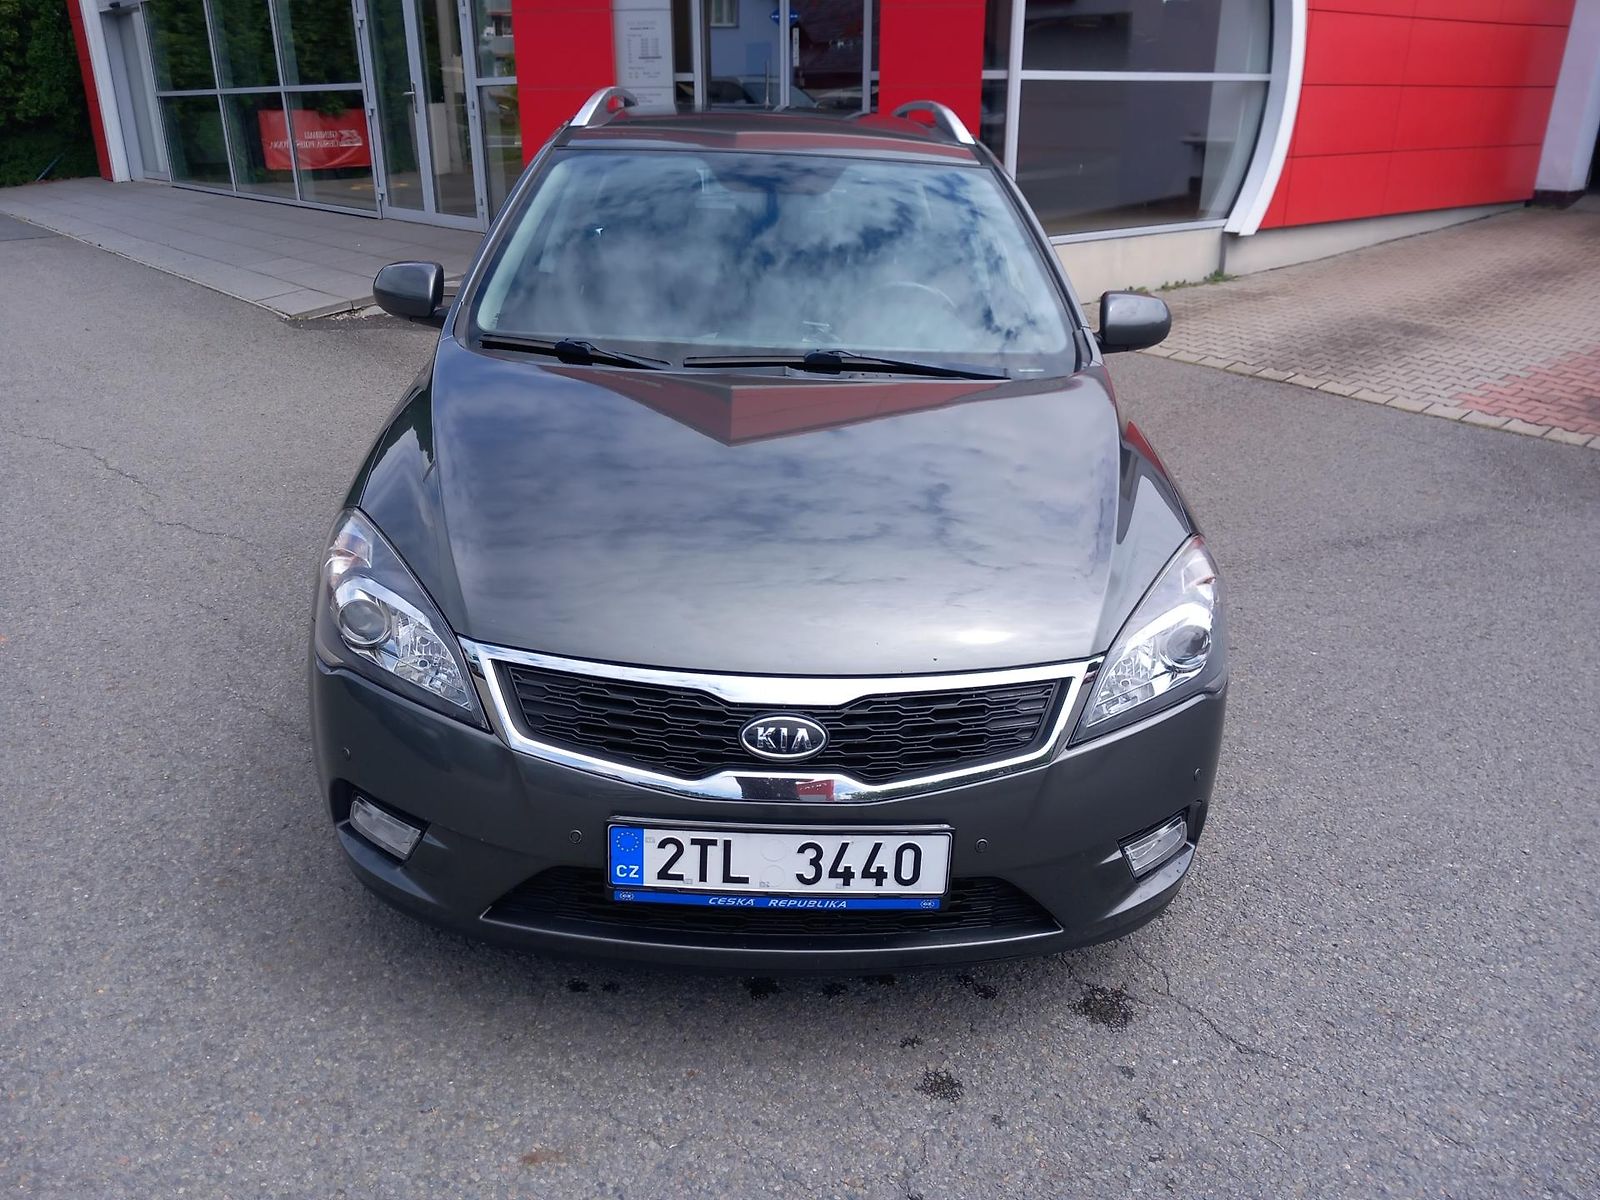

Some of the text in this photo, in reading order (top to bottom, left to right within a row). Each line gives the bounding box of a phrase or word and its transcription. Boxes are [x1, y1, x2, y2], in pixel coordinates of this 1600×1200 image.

[757, 727, 812, 749] KIA
[657, 837, 922, 887] 2TL 3440
[616, 865, 639, 878] CZ
[768, 898, 847, 909] REPUBLIKA
